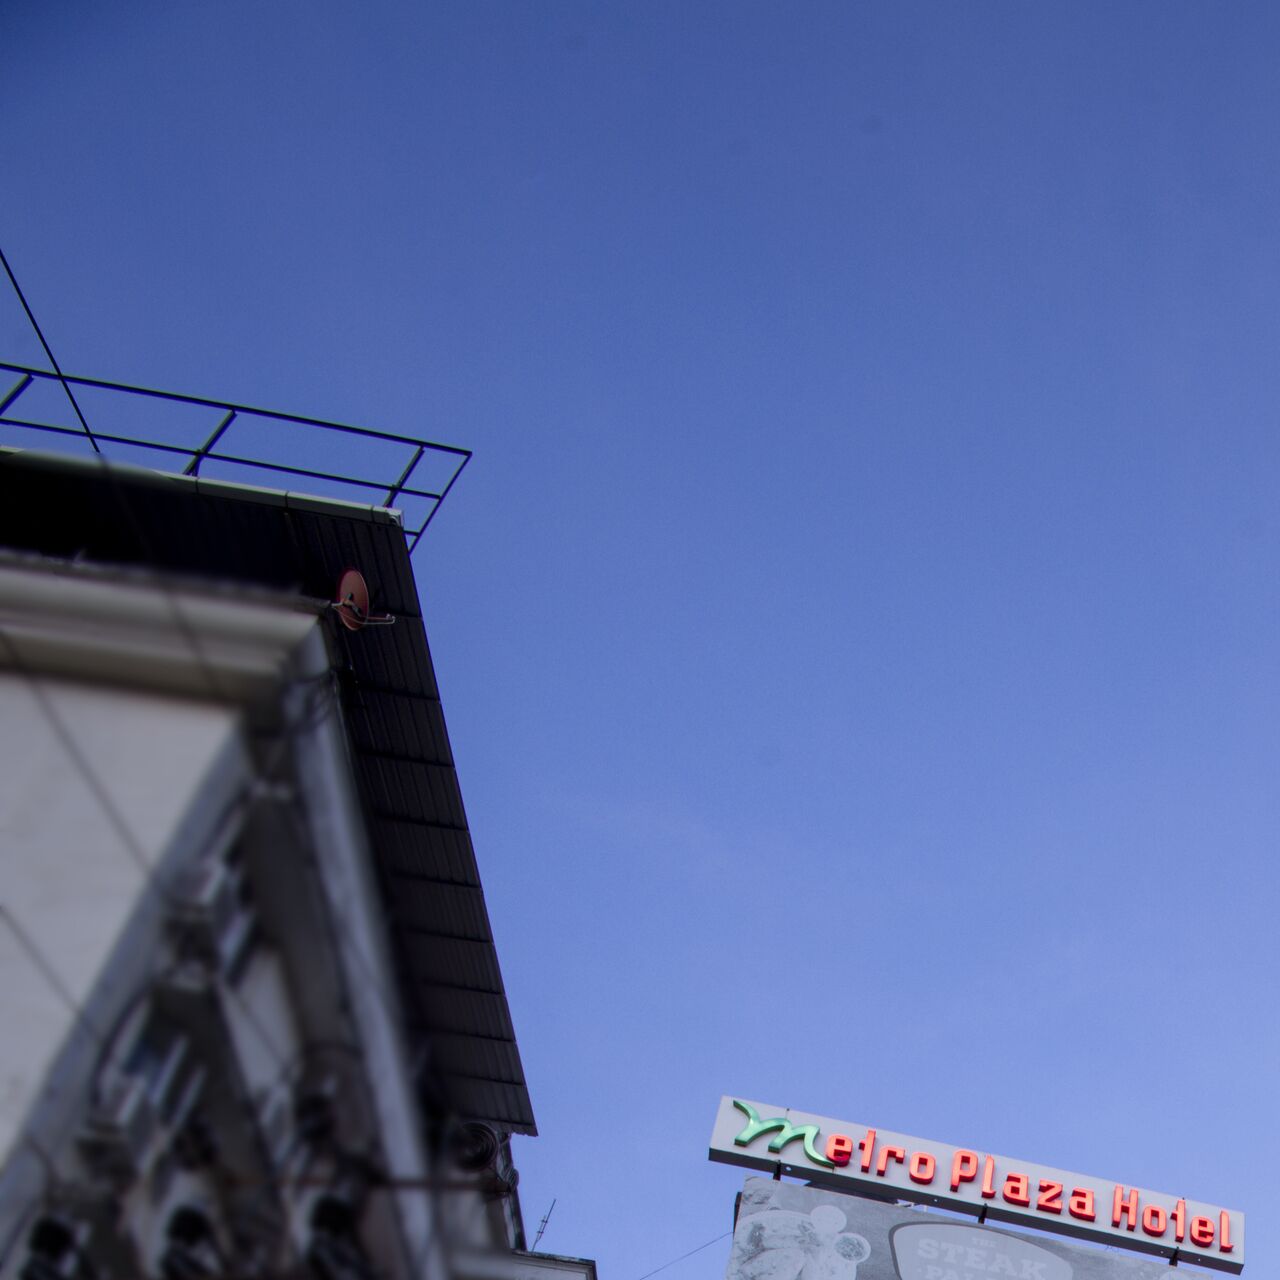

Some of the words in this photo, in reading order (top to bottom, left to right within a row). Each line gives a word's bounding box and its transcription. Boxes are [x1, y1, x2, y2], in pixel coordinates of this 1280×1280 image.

[733, 1099, 936, 1186] Metro
[950, 1149, 1096, 1222] Plaza
[1111, 1184, 1235, 1253] Hotel
